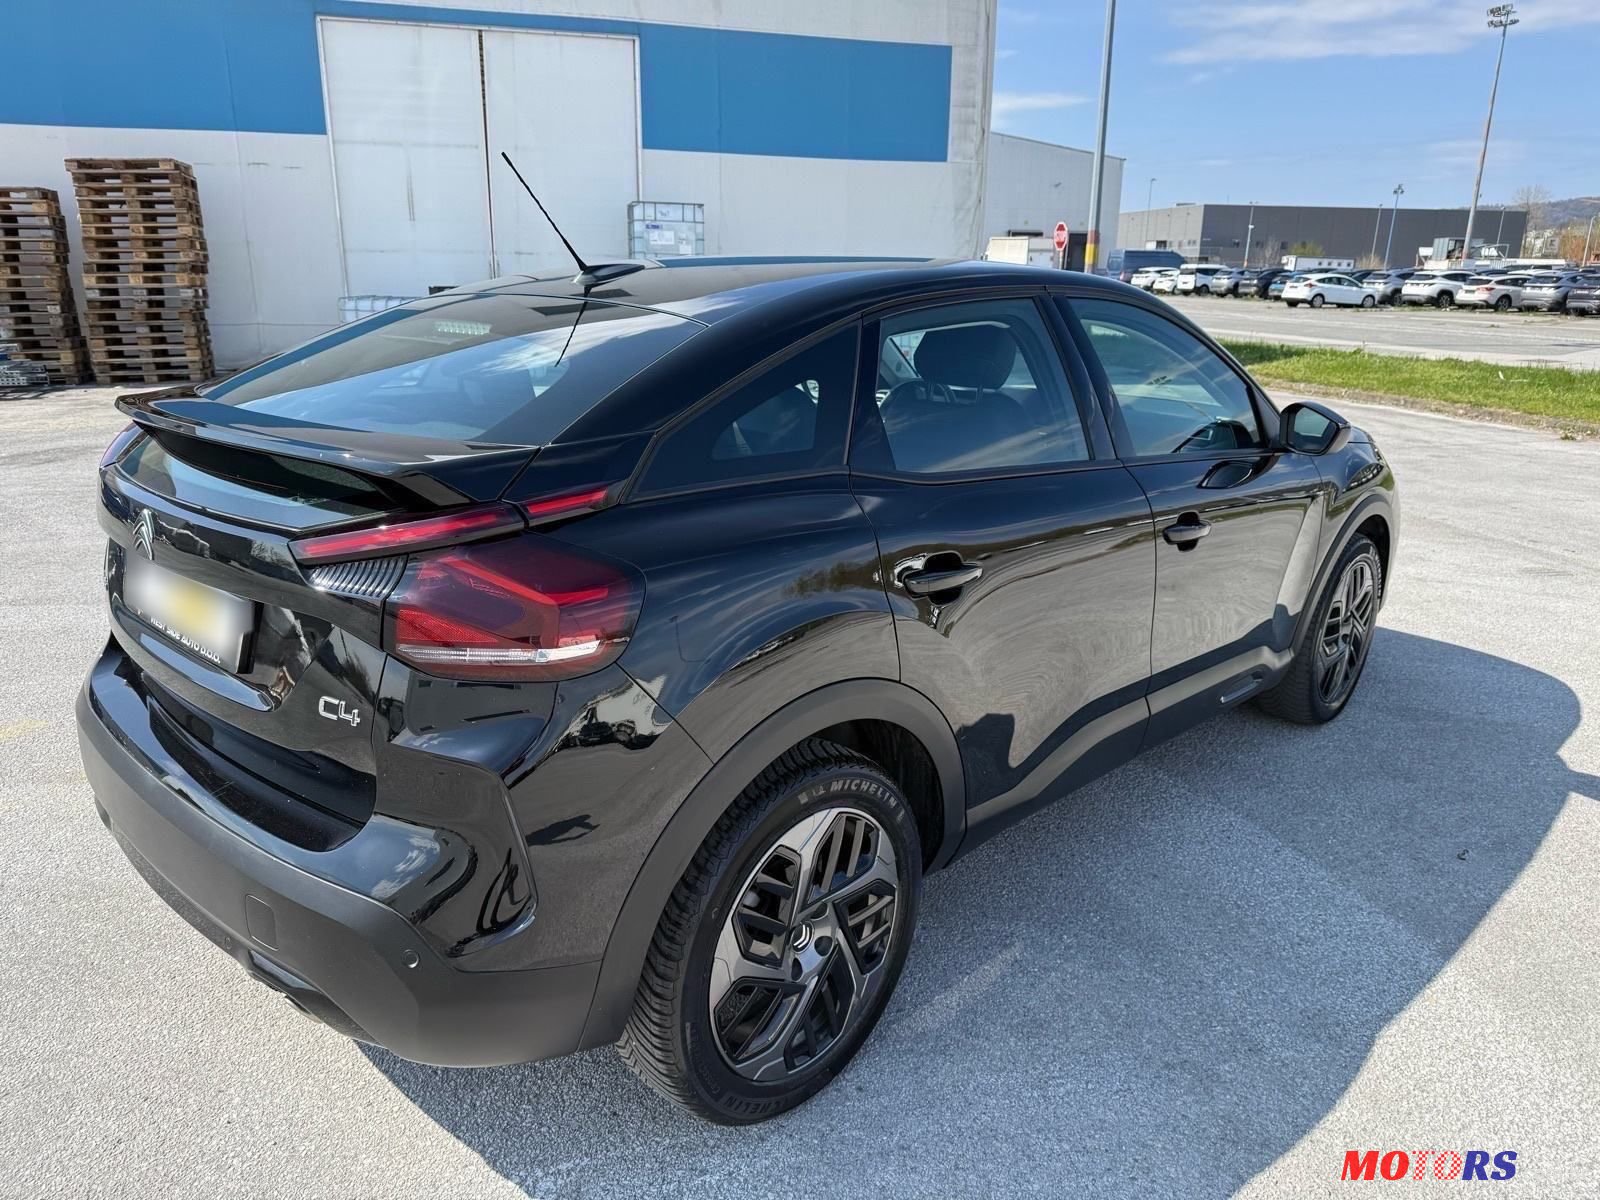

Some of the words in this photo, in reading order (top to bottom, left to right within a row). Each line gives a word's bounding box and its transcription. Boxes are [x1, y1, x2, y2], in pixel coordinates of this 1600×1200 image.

[180, 635, 199, 651] AUTO
[318, 695, 361, 727] C4
[830, 779, 898, 809] MICHELIN
